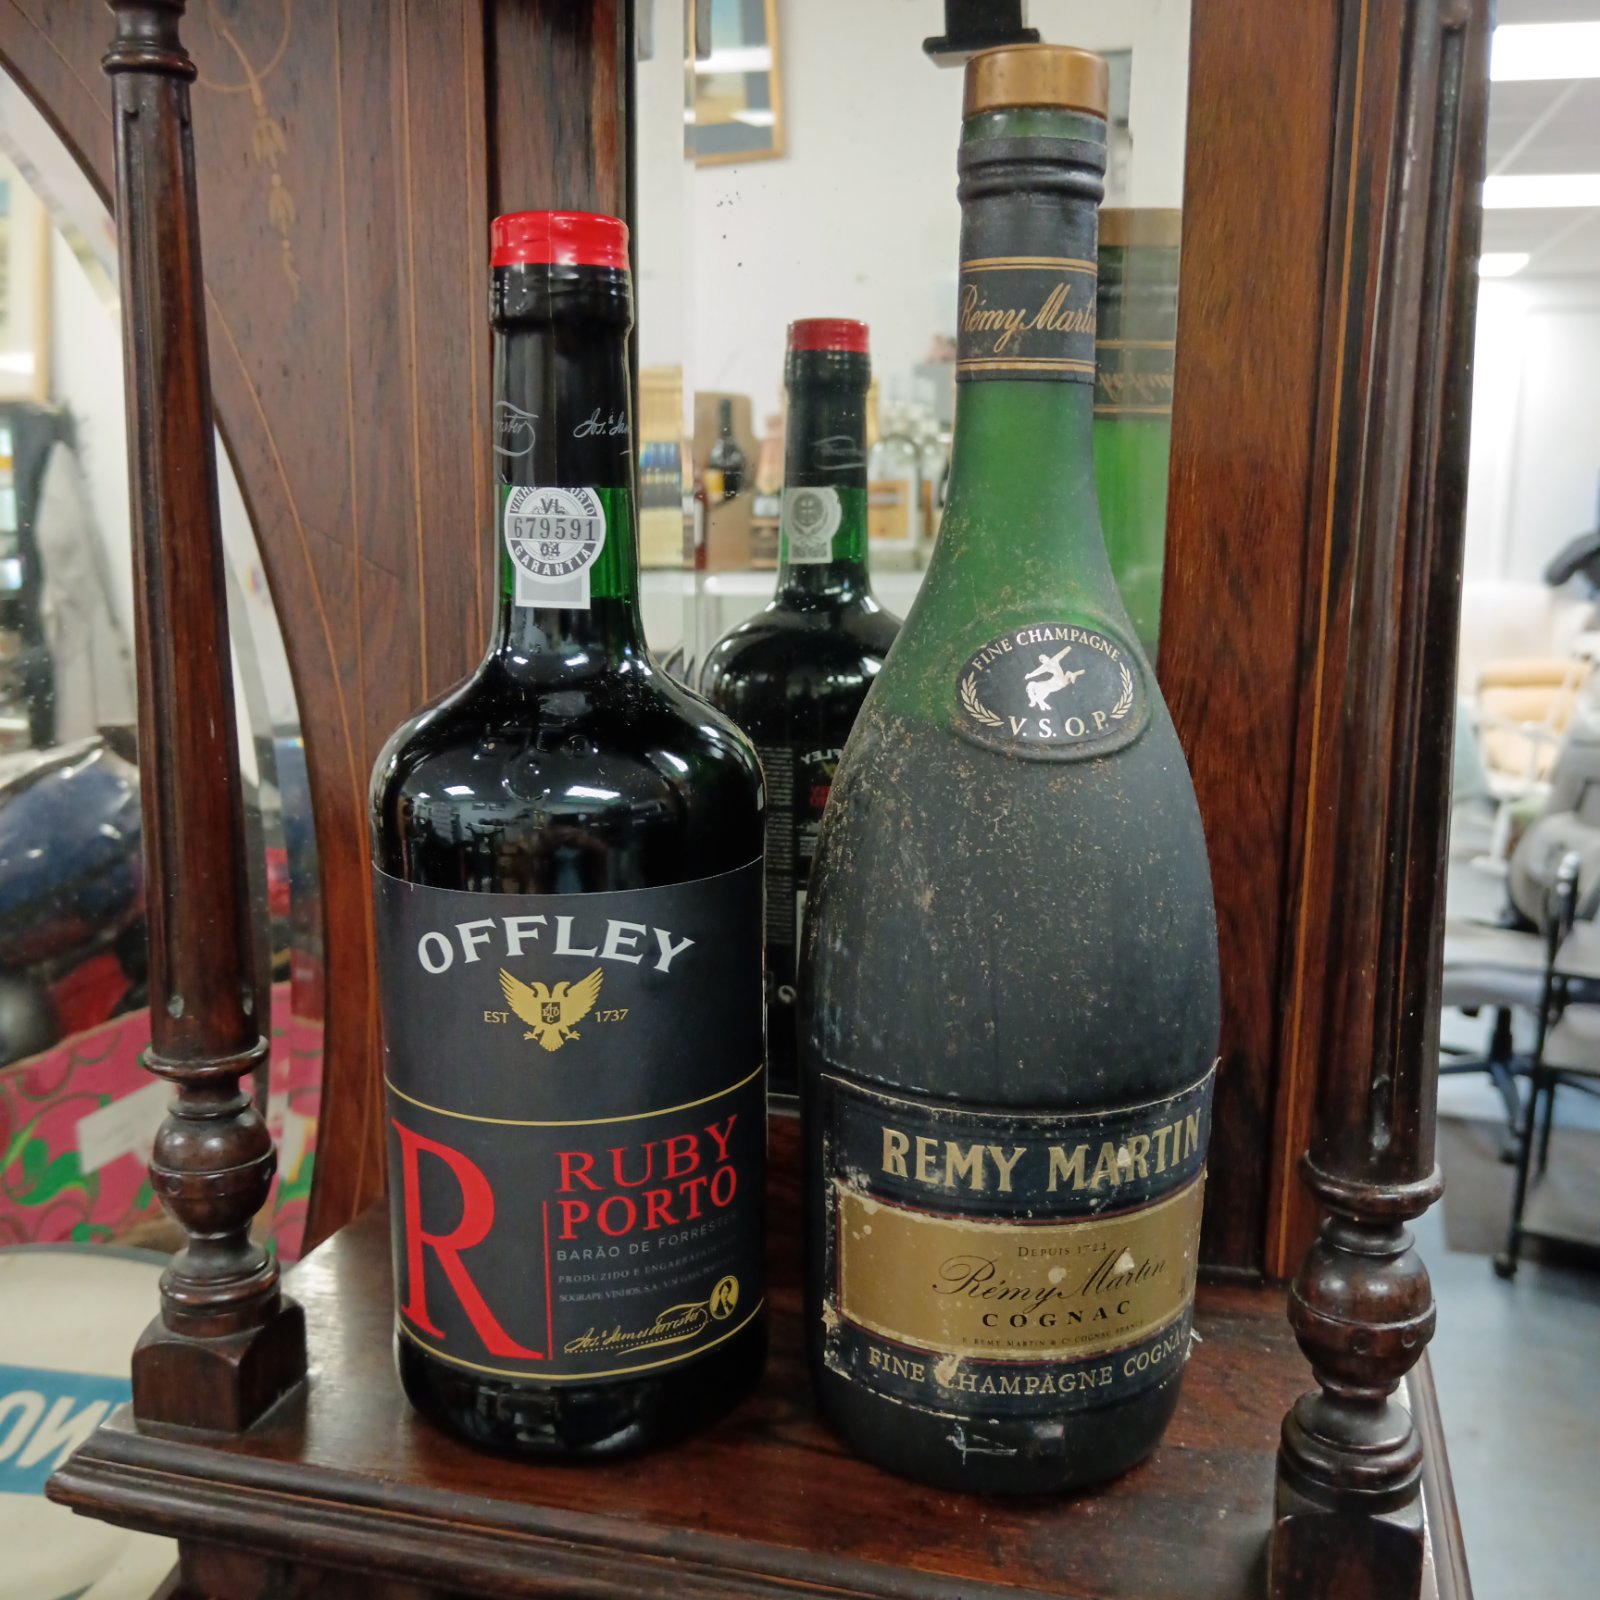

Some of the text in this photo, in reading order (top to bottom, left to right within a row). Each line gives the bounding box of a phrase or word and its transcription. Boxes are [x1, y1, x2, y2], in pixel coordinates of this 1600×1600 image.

[514, 517, 596, 541] 679591
[514, 548, 592, 576] GARANTIA
[971, 627, 1121, 672] FINE CHAMPAGNE
[418, 914, 696, 974] OFFLEY
[483, 1010, 510, 1024] EST
[594, 1008, 629, 1023] 1737
[555, 1114, 738, 1192] RUBY
[881, 1106, 1201, 1192] REMY MARTIN
[557, 1164, 738, 1240] PORTO
[390, 1115, 545, 1361] R
[556, 1246, 620, 1261] BARÃO
[629, 1241, 651, 1255] DE
[1018, 1246, 1071, 1258] DEPUIS
[558, 1270, 629, 1284] PRODUZIDO
[982, 1301, 1131, 1328] COGNAC
[868, 1345, 926, 1383] FINE
